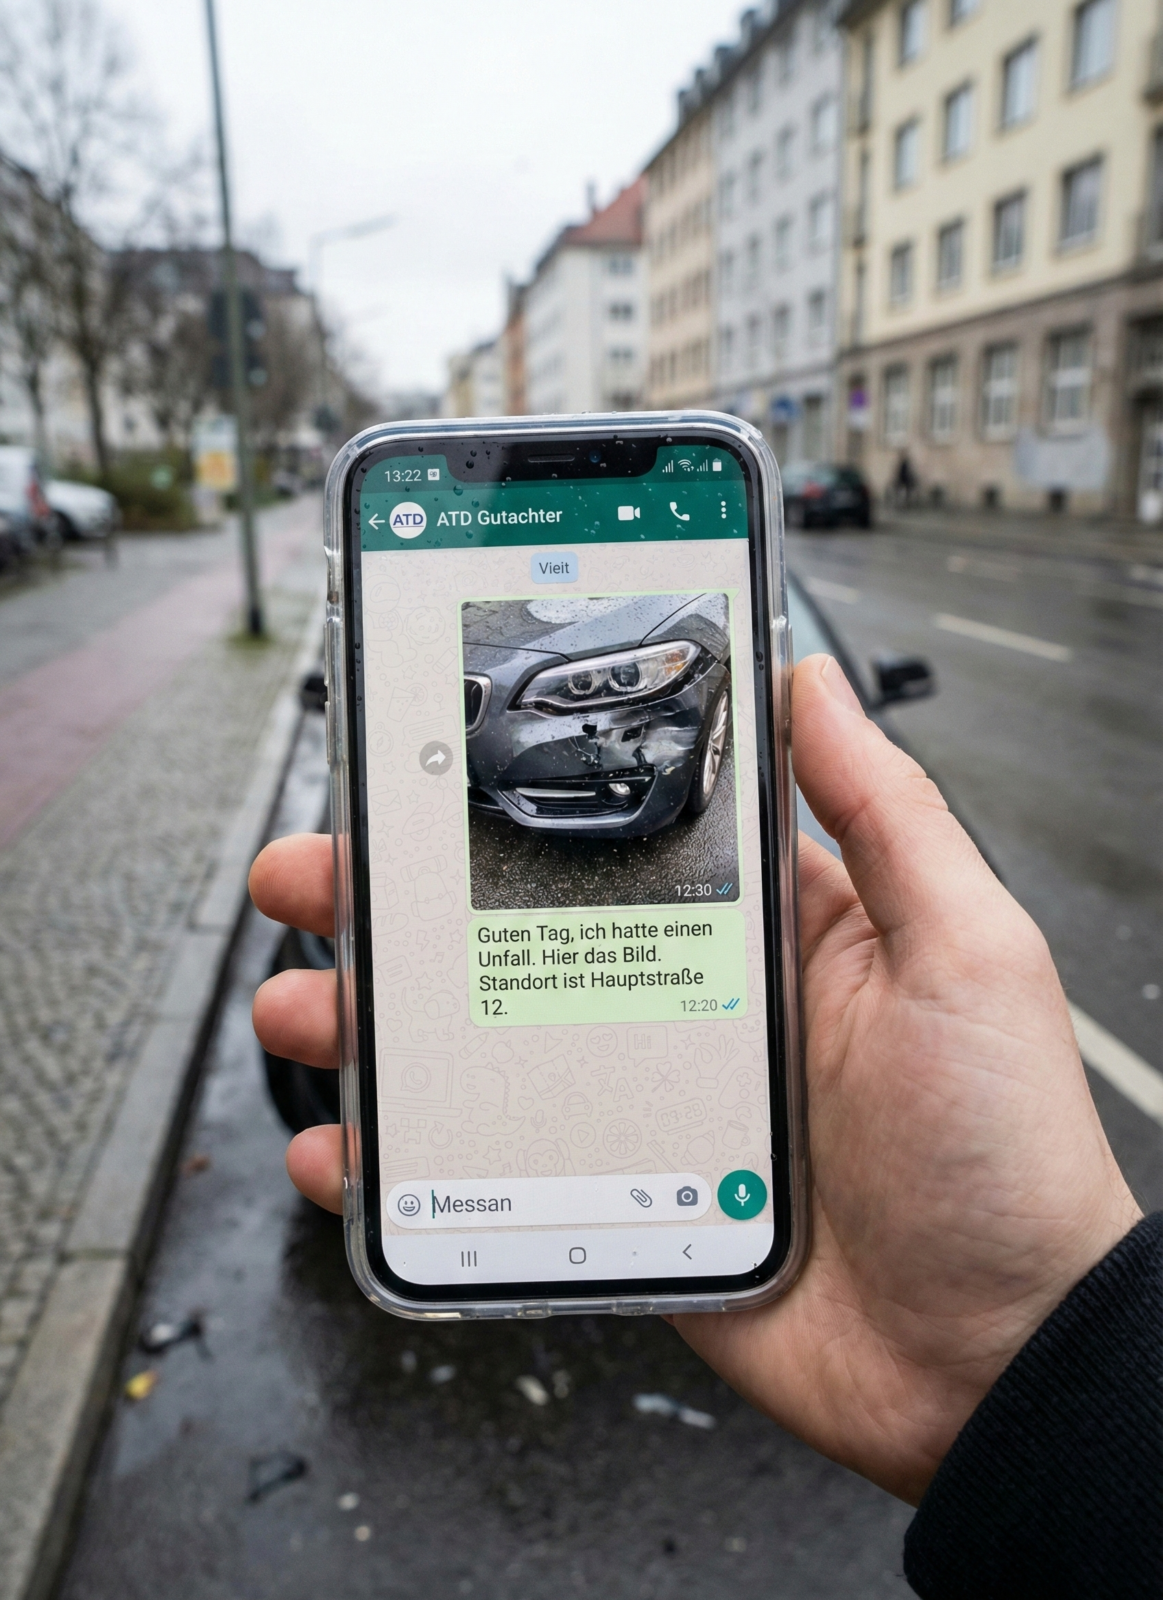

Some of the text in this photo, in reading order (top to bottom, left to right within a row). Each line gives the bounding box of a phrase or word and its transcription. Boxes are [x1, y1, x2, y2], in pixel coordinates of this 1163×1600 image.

[384, 469, 422, 482] 13:22
[393, 513, 424, 526] ATD
[436, 507, 563, 527] ATD Gutachter
[538, 561, 570, 575] Vieit
[674, 883, 712, 897] 12:30
[477, 920, 712, 945] Guten Tag, ich hatte einen
[478, 945, 661, 967] Unfall. Hier das Bild.
[479, 967, 704, 991] Standort ist Hauptstraße
[480, 998, 508, 1016] 12.
[680, 999, 718, 1012] 12:20
[433, 1195, 512, 1213] Messan
